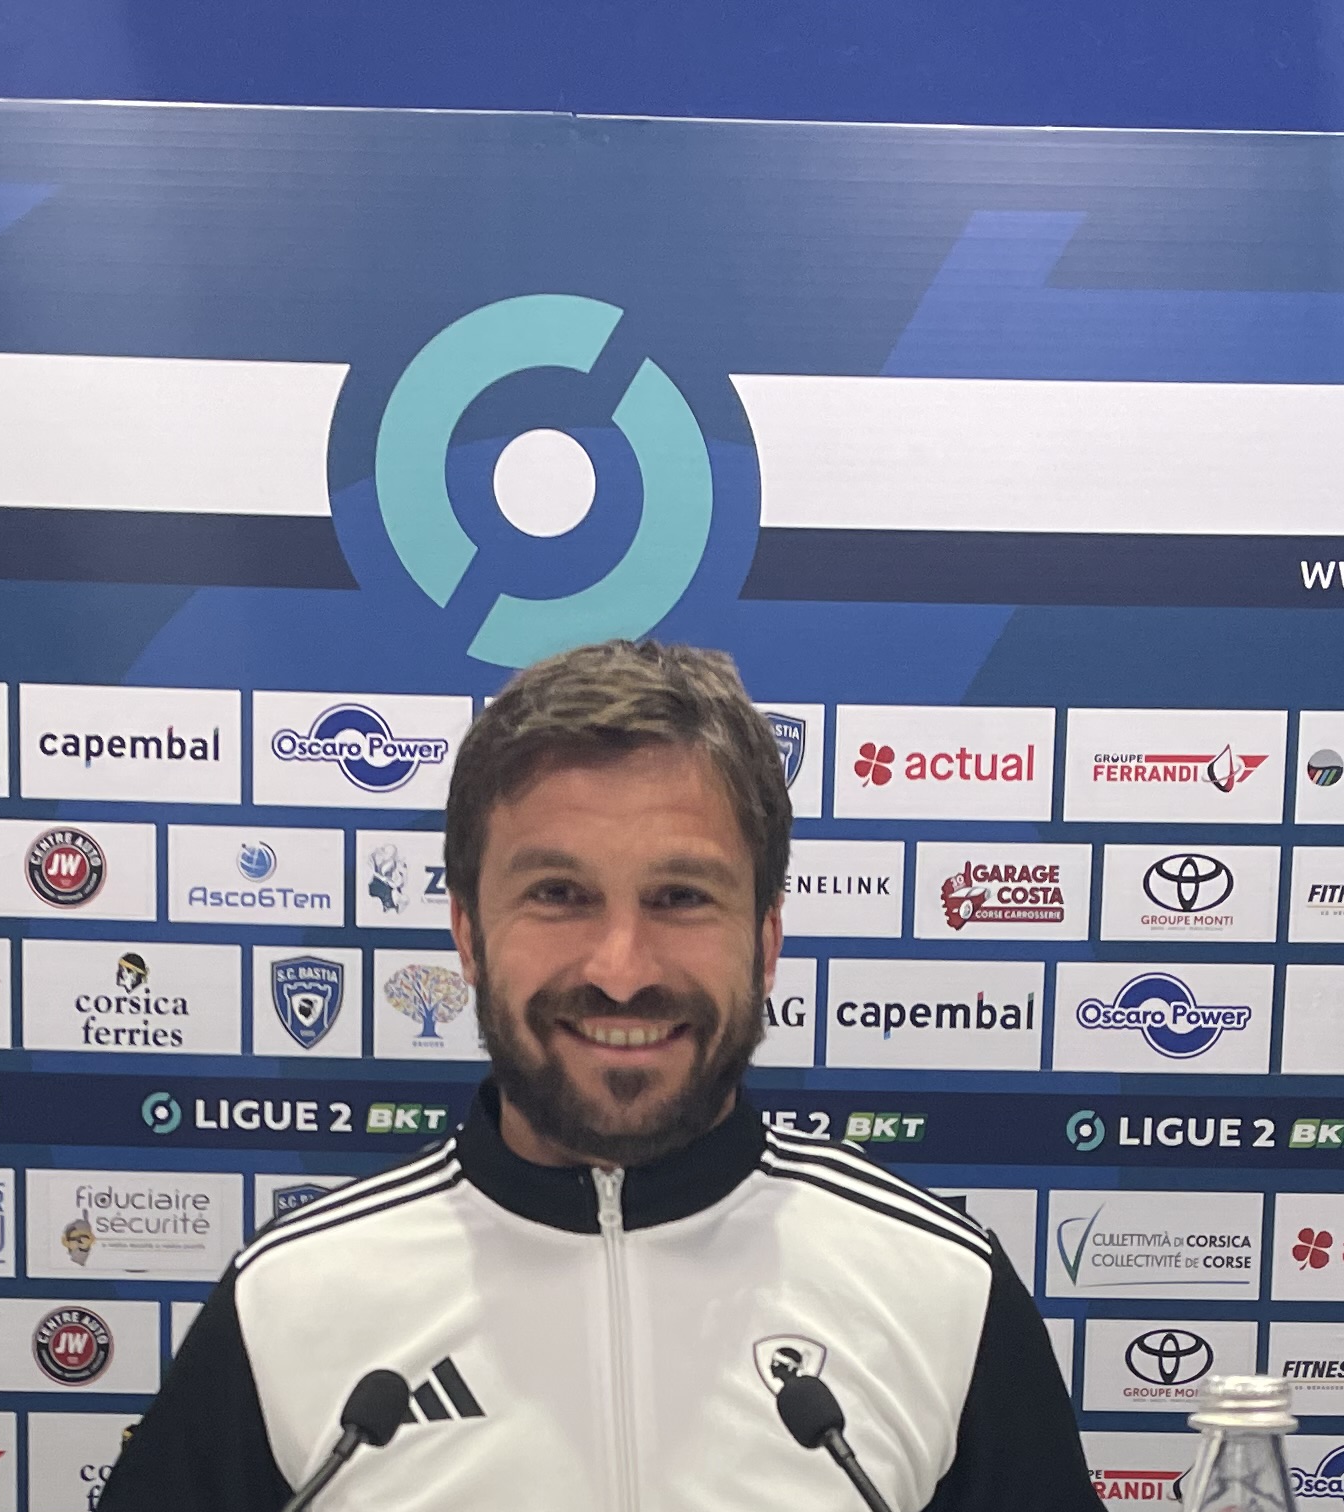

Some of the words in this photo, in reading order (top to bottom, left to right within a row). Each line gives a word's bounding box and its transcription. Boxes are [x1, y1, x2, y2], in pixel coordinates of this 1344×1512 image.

[39, 726, 220, 767] capembal
[277, 736, 361, 758] Oscaro
[368, 737, 443, 762] Power
[904, 745, 1034, 781] actual
[1094, 753, 1143, 763] GROUPE
[1094, 765, 1198, 782] FERRANDI
[972, 865, 1059, 884] GARAGE
[189, 887, 331, 909] Asco6Tem
[998, 886, 1064, 904] COSTA
[1141, 915, 1191, 926] GROUPE
[1194, 915, 1233, 926] MONTI
[75, 987, 189, 1017] corsica
[836, 992, 1034, 1040] capembal
[1081, 1006, 1165, 1026] Oscaro
[1172, 1006, 1246, 1029] Power
[82, 1018, 183, 1047] ferries
[1119, 1117, 1242, 1147] LIGUE
[1252, 1119, 1276, 1149] 2
[75, 1186, 210, 1211] fiduciaire
[96, 1212, 210, 1234] sécurité
[1187, 1235, 1251, 1249] CORSICA
[1092, 1253, 1182, 1268] COLLECTIVITÉ
[1185, 1258, 1199, 1268] DE
[1203, 1254, 1251, 1269] CORSE
